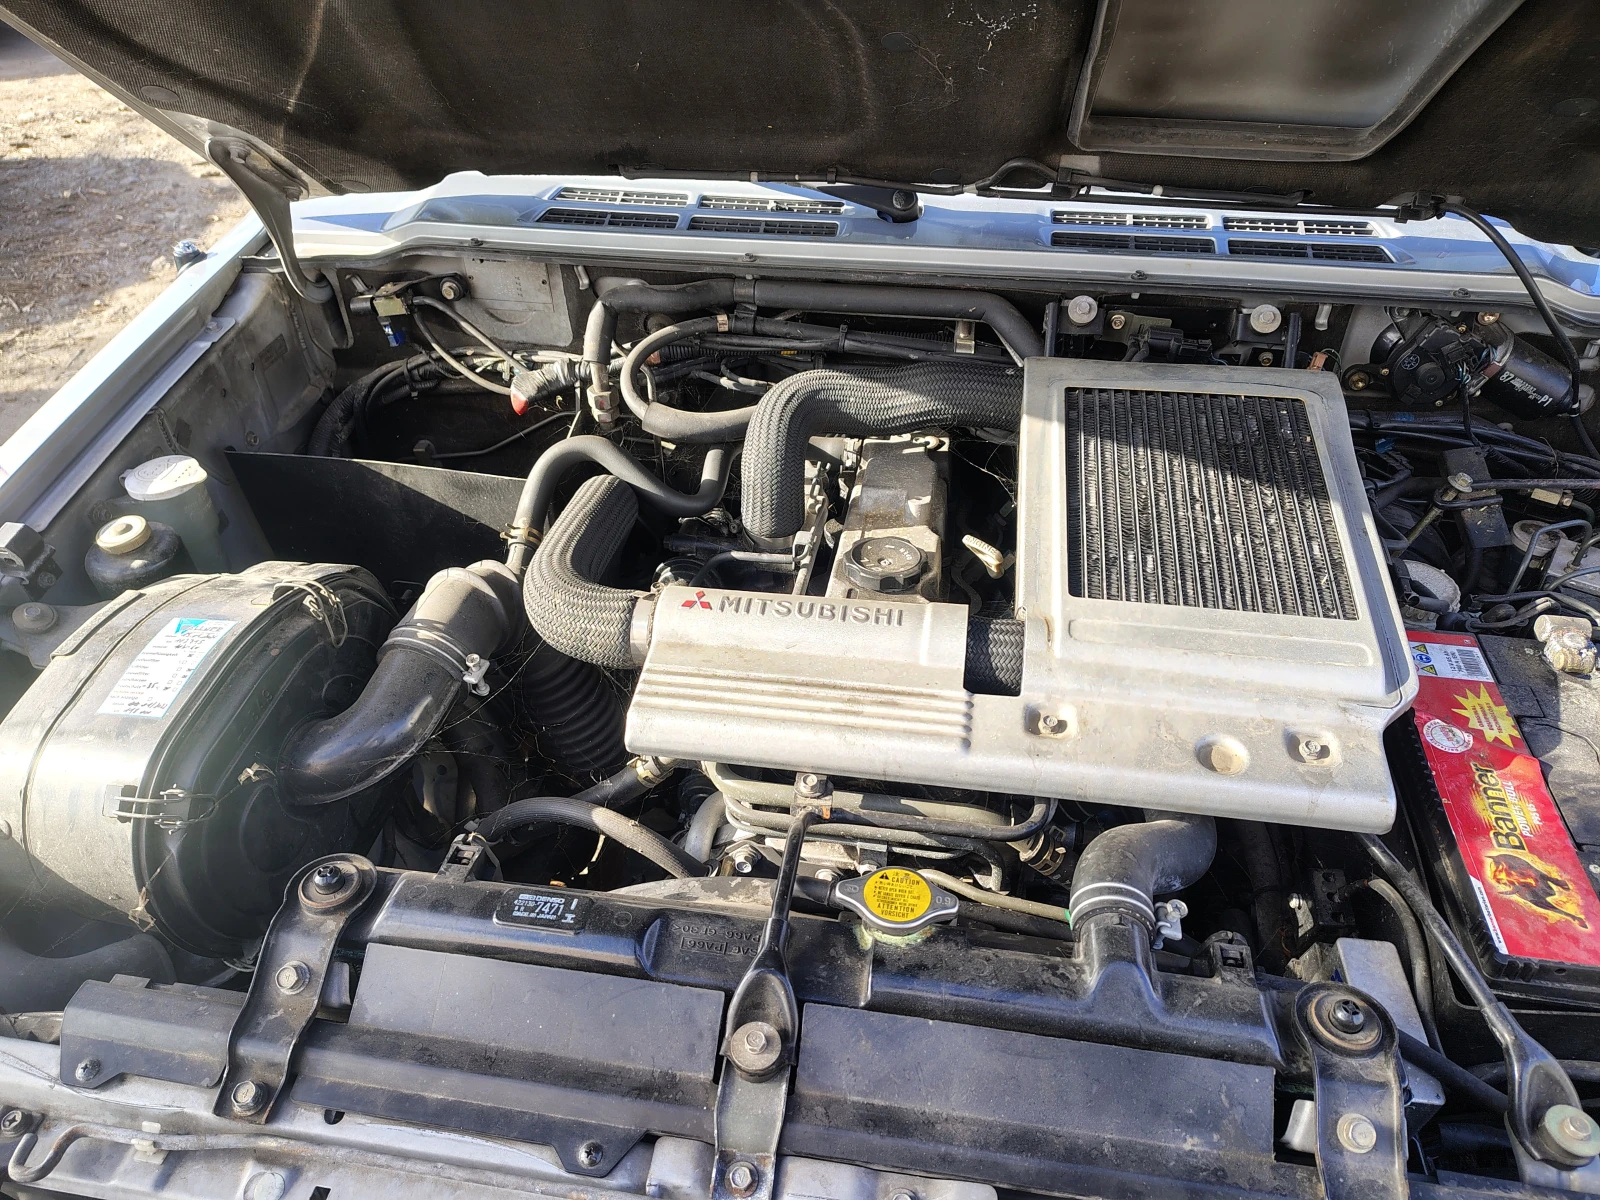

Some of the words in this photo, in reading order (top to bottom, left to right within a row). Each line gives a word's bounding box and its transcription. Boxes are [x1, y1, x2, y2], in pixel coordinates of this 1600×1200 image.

[716, 594, 904, 627] MITSUBISHI
[1502, 780, 1518, 804] BULL
[1470, 760, 1528, 852] Banner
[1511, 804, 1534, 838] POWER
[891, 876, 920, 886] CAUTION
[877, 903, 915, 913] ATTENTION
[935, 896, 951, 905] 0.9
[881, 909, 910, 918] VORSICHT
